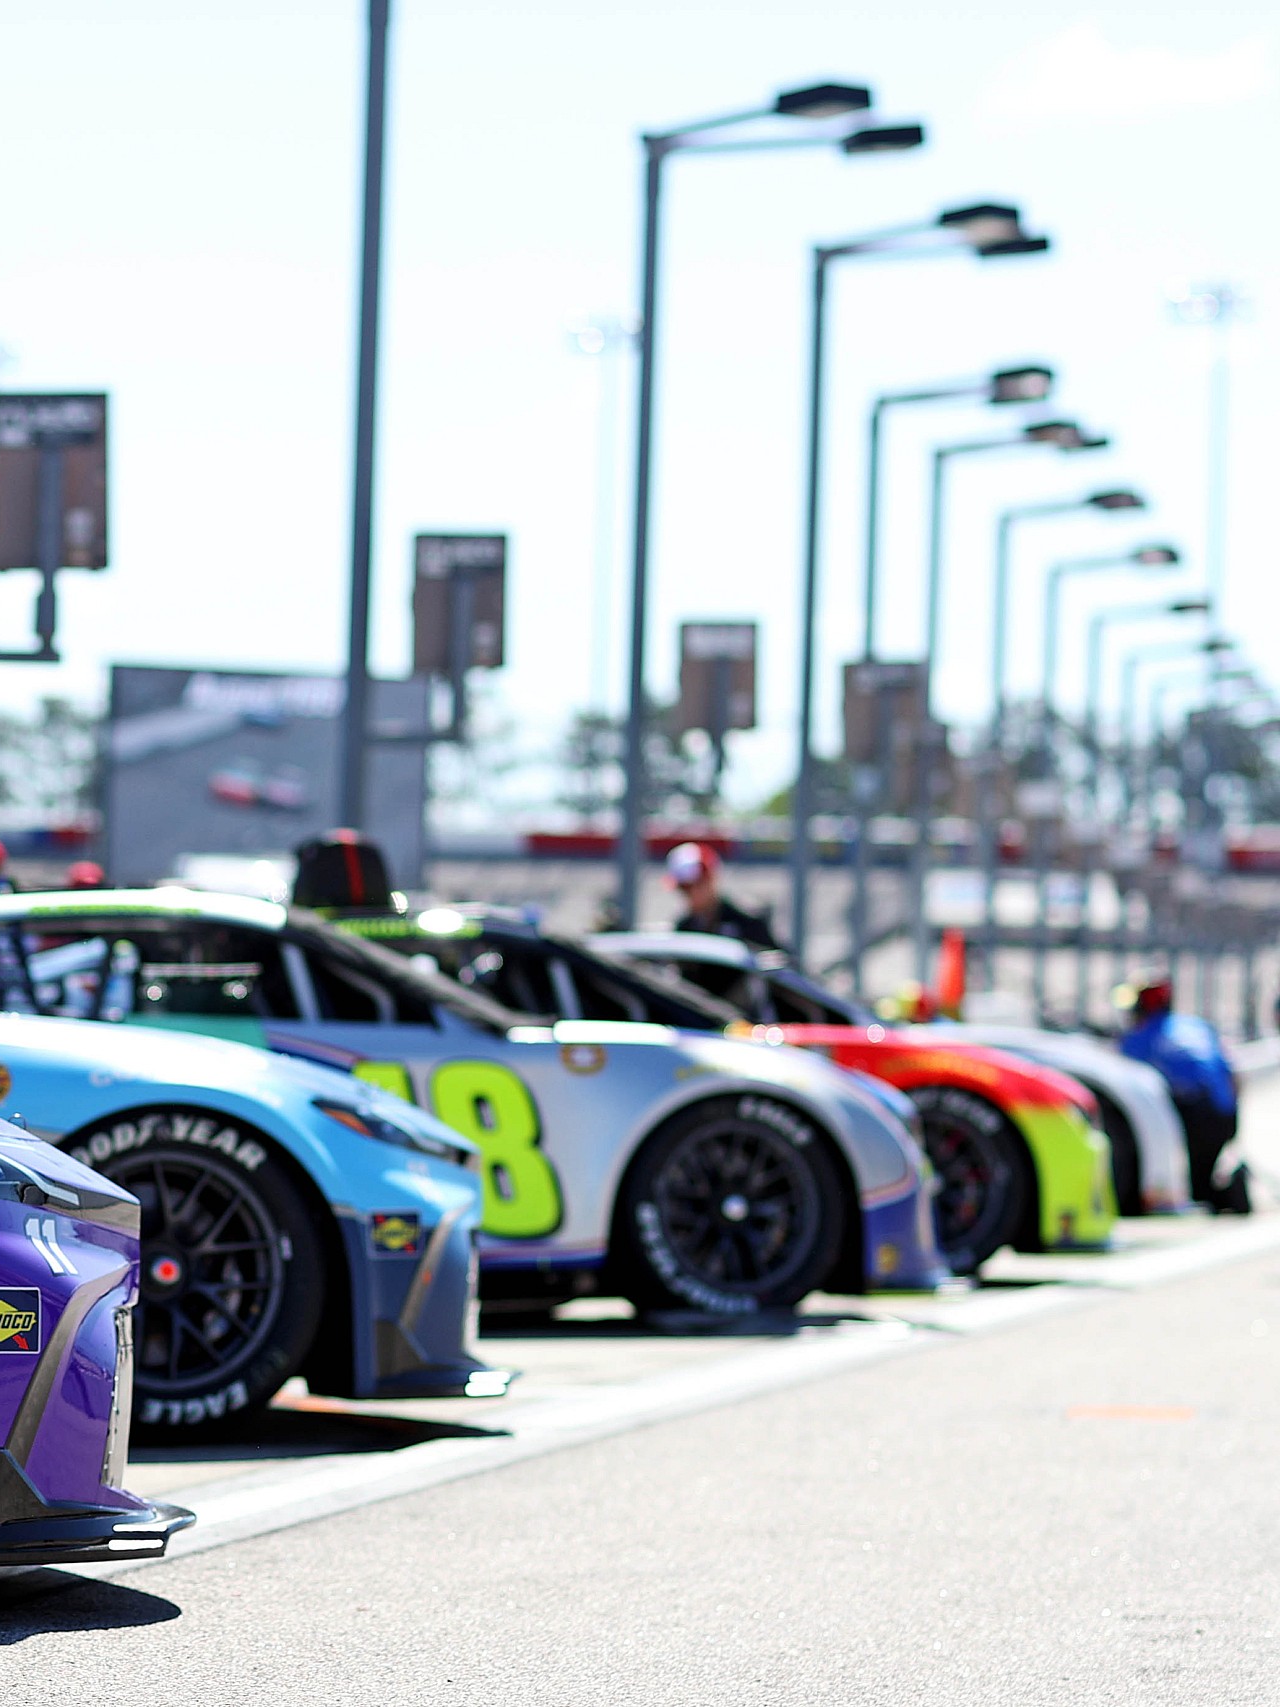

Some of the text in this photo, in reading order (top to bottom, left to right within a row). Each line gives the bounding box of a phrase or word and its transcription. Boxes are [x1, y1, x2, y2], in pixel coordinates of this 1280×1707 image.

[352, 1058, 564, 1239] 8
[24, 1216, 80, 1277] 11
[141, 1378, 249, 1425] EAGLE
